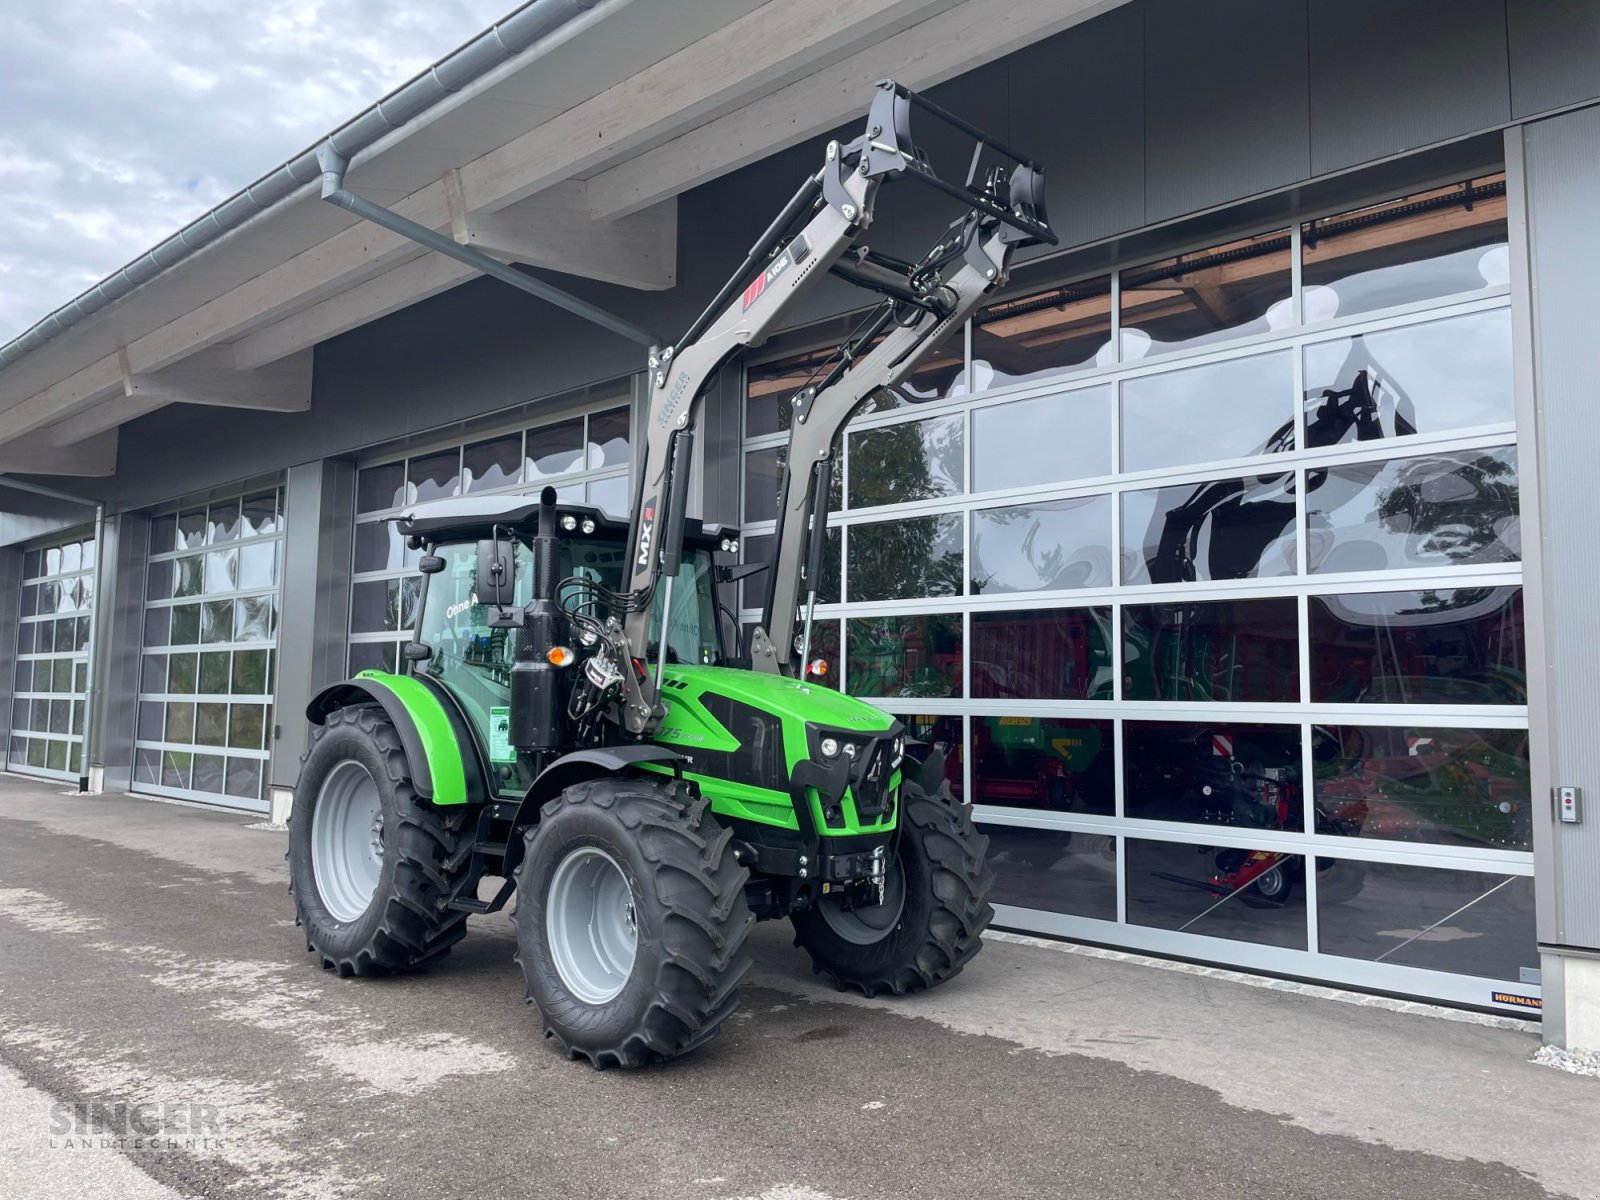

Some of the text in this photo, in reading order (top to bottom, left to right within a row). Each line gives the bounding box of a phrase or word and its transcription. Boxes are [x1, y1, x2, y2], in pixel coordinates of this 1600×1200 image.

[766, 256, 788, 282] A106
[656, 370, 689, 426] SINGER
[638, 522, 653, 565] MX
[446, 600, 470, 619] Ohne
